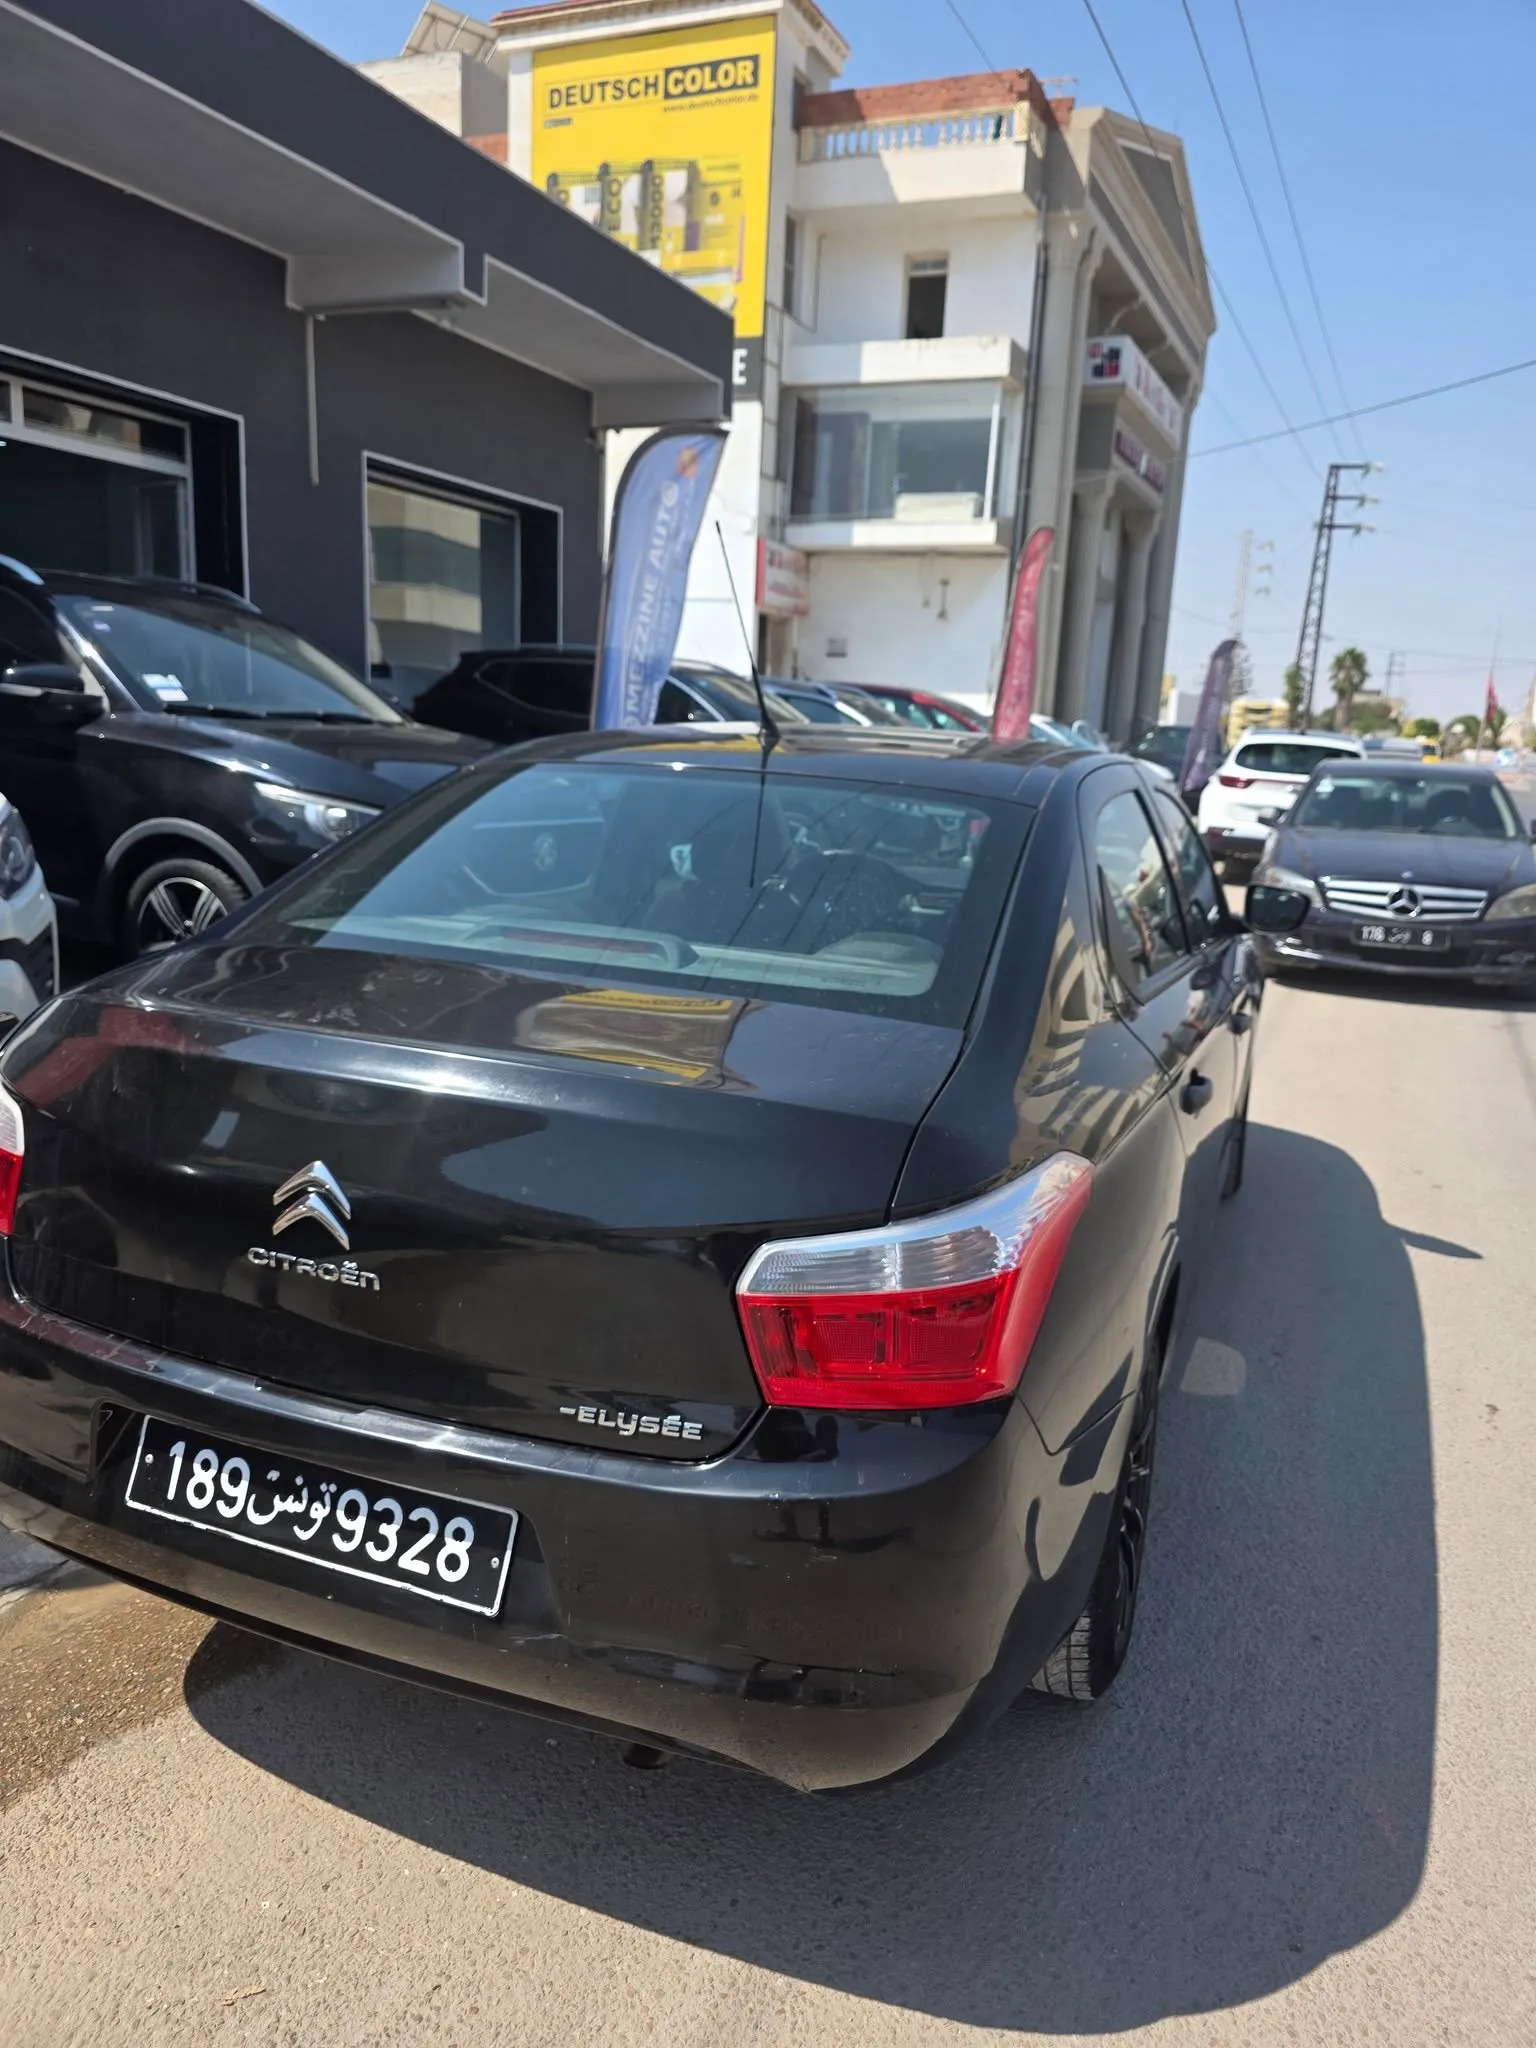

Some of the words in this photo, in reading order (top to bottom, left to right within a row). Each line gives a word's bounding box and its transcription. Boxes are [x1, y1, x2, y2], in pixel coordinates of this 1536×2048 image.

[549, 74, 660, 109] DEUTSCH
[666, 60, 755, 96] COLOR
[247, 1246, 381, 1291] CITROËN
[166, 1440, 251, 1519] 189
[246, 1469, 338, 1541] تونس
[331, 1488, 475, 1583] 9328
